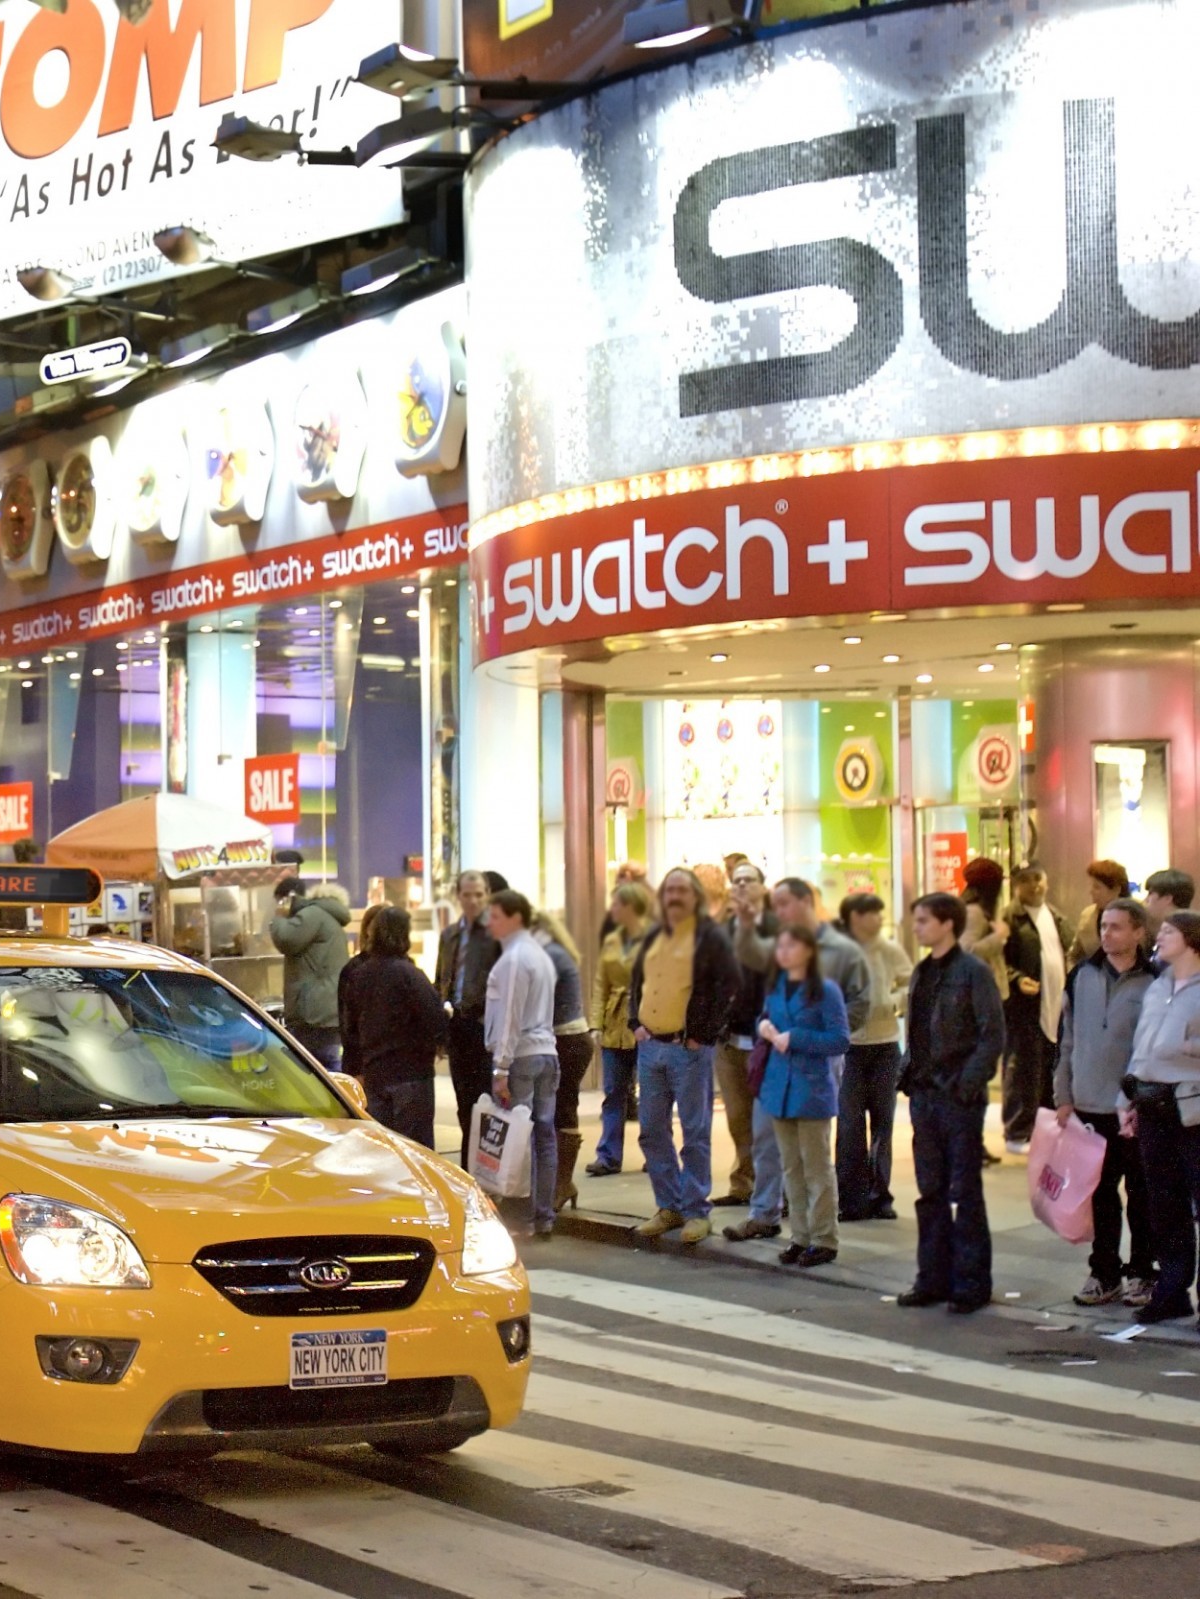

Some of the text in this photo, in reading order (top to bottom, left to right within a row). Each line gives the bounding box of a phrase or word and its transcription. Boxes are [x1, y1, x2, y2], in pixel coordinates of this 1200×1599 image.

[70, 146, 133, 206] Hot
[150, 130, 195, 184] As
[904, 486, 1200, 586] swa
[249, 767, 295, 813] SALE
[308, 1266, 344, 1282] KIA
[314, 1332, 365, 1346] NEW YORK
[294, 1346, 385, 1376] NEW YORK CITY
